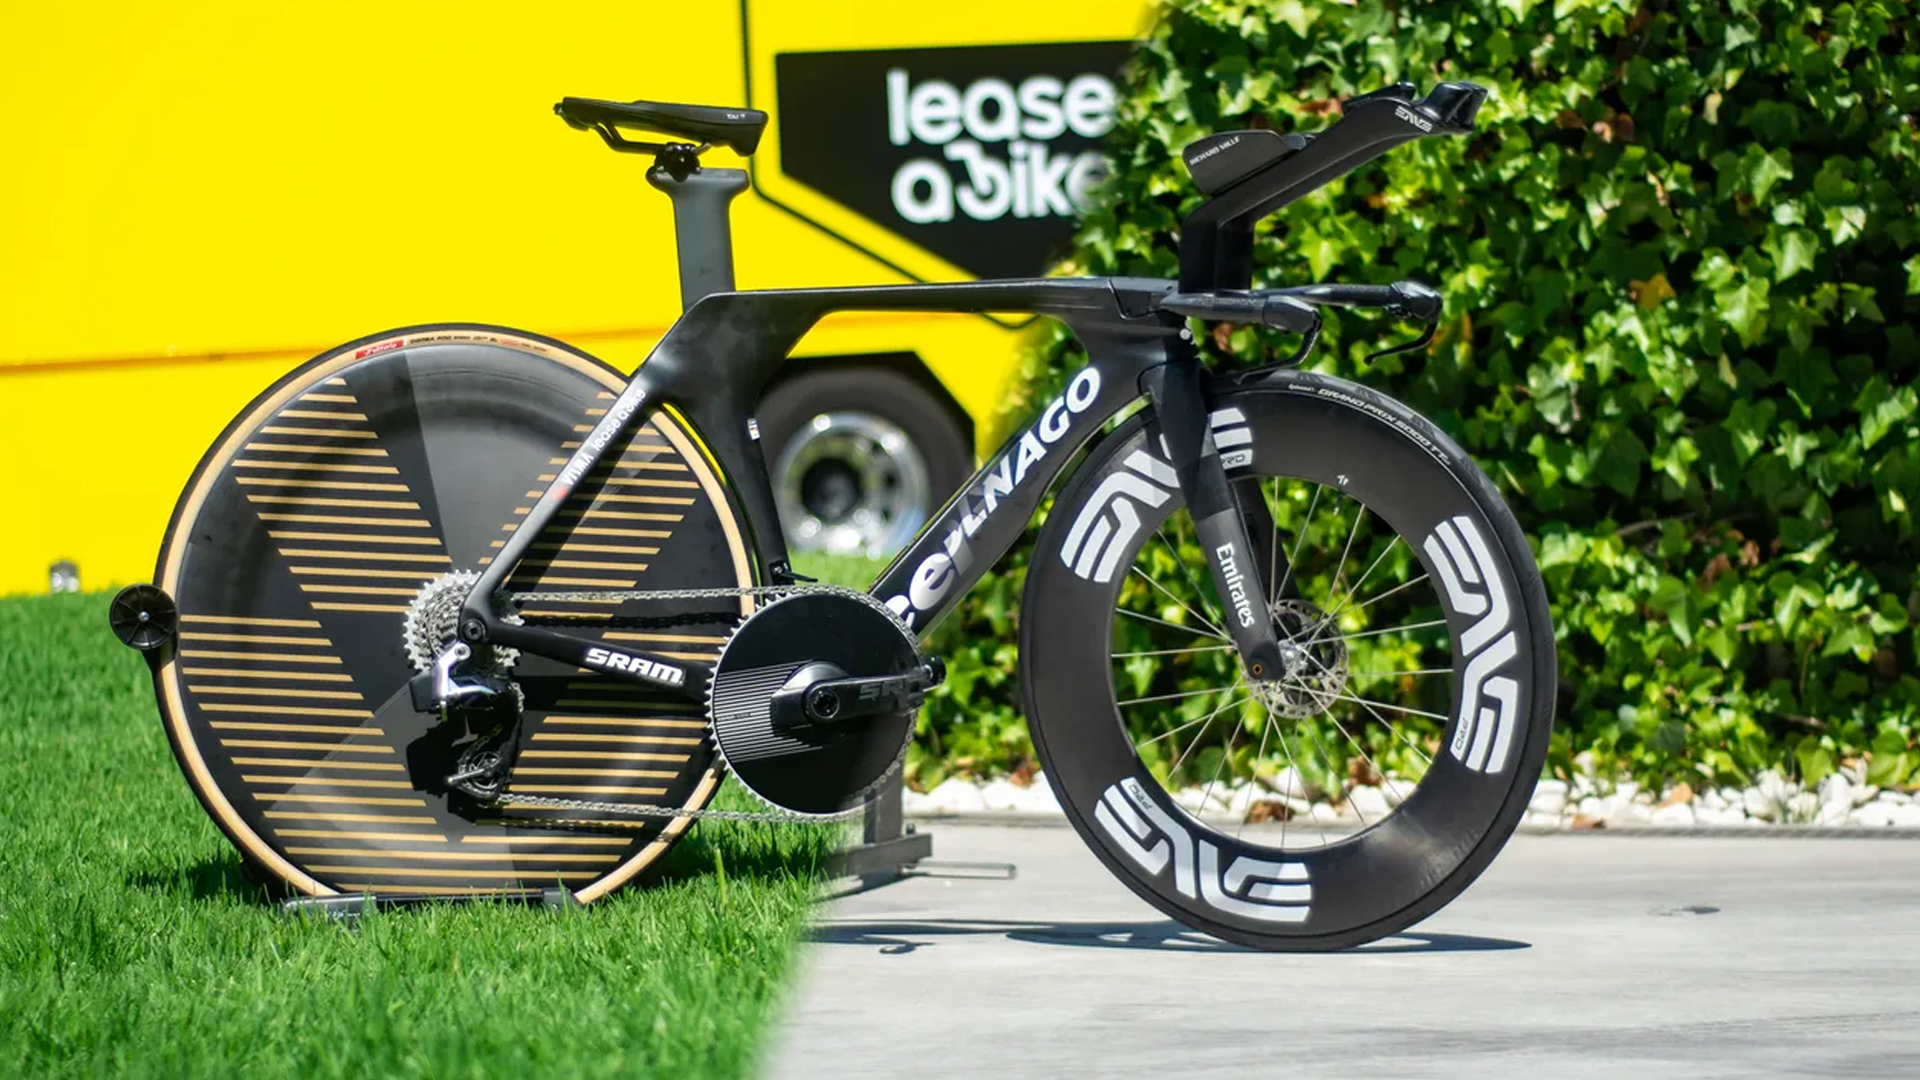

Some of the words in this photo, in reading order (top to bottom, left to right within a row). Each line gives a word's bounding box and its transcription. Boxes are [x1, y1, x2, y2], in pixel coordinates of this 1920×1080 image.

[886, 69, 1116, 146] lease
[1318, 388, 1366, 408] GRAND
[1363, 404, 1397, 422] PRIX
[1215, 542, 1255, 628] Emirates
[585, 648, 684, 684] SRAM
[1423, 516, 1518, 774] ENVE
[1094, 777, 1311, 922] ENVE
